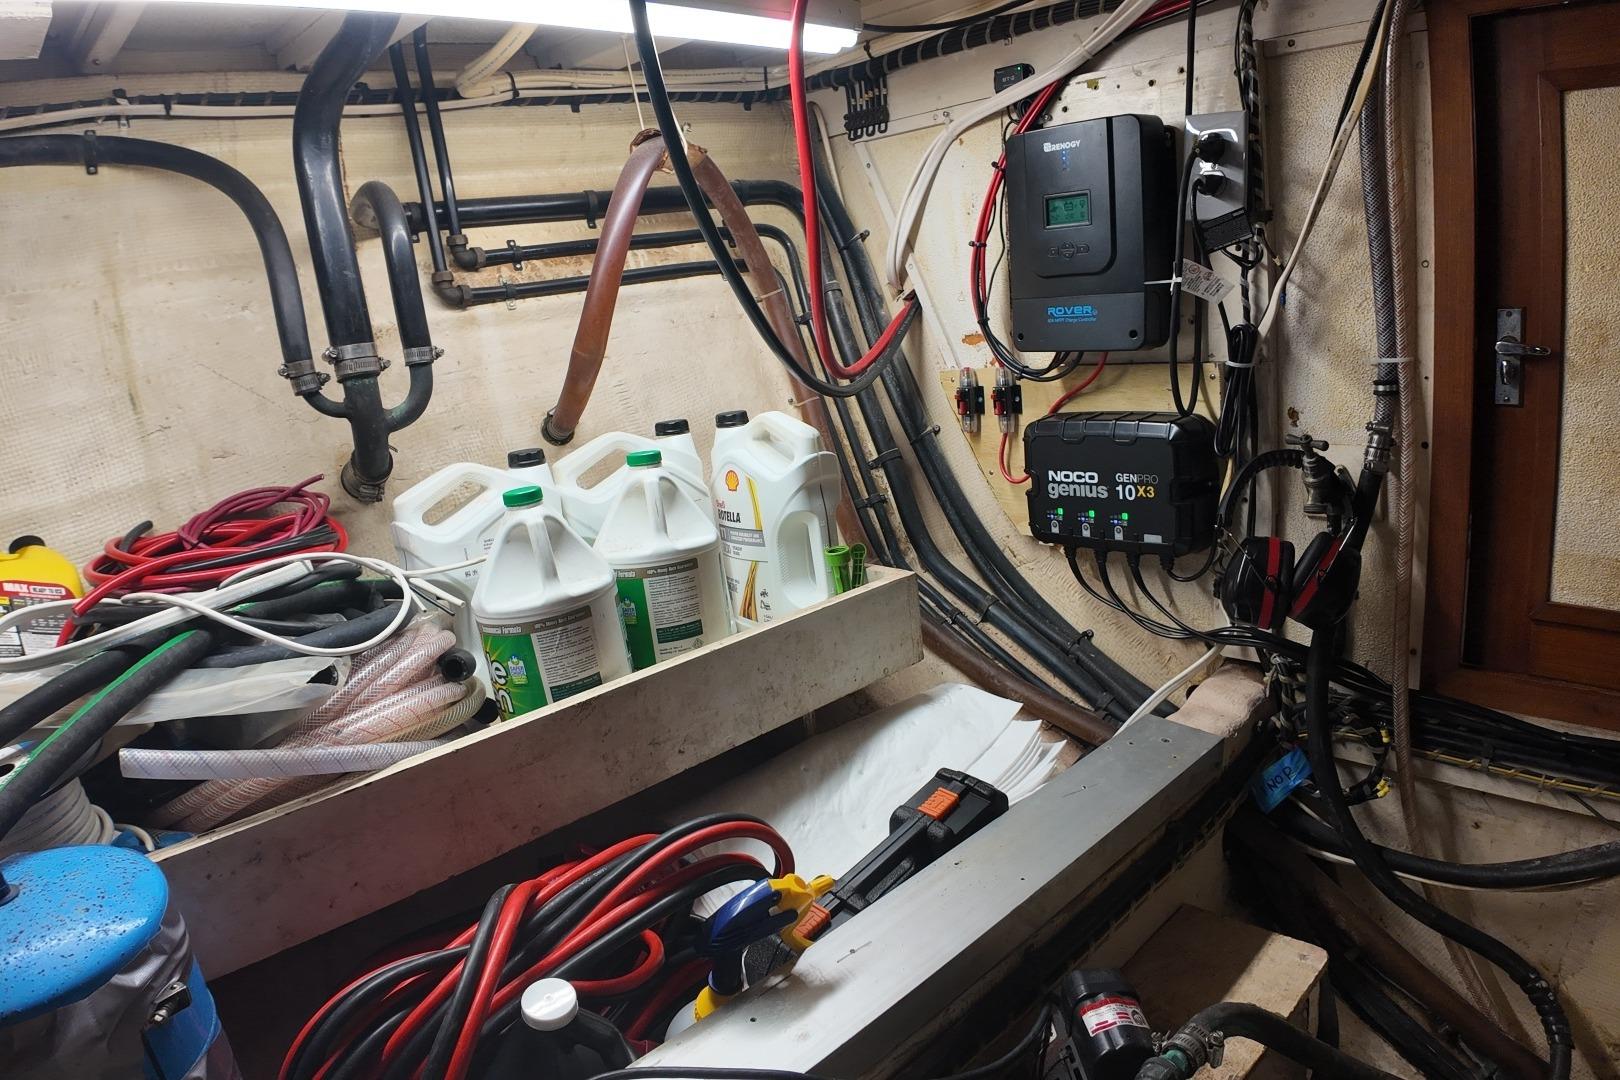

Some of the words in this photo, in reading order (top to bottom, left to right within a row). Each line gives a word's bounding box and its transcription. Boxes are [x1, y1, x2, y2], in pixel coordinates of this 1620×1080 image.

[1050, 139, 1081, 151] RENOGY
[1047, 305, 1093, 317] ROVER
[1048, 471, 1099, 483] NOCO
[1115, 473, 1159, 484] GENPRO
[1048, 482, 1109, 499] genius
